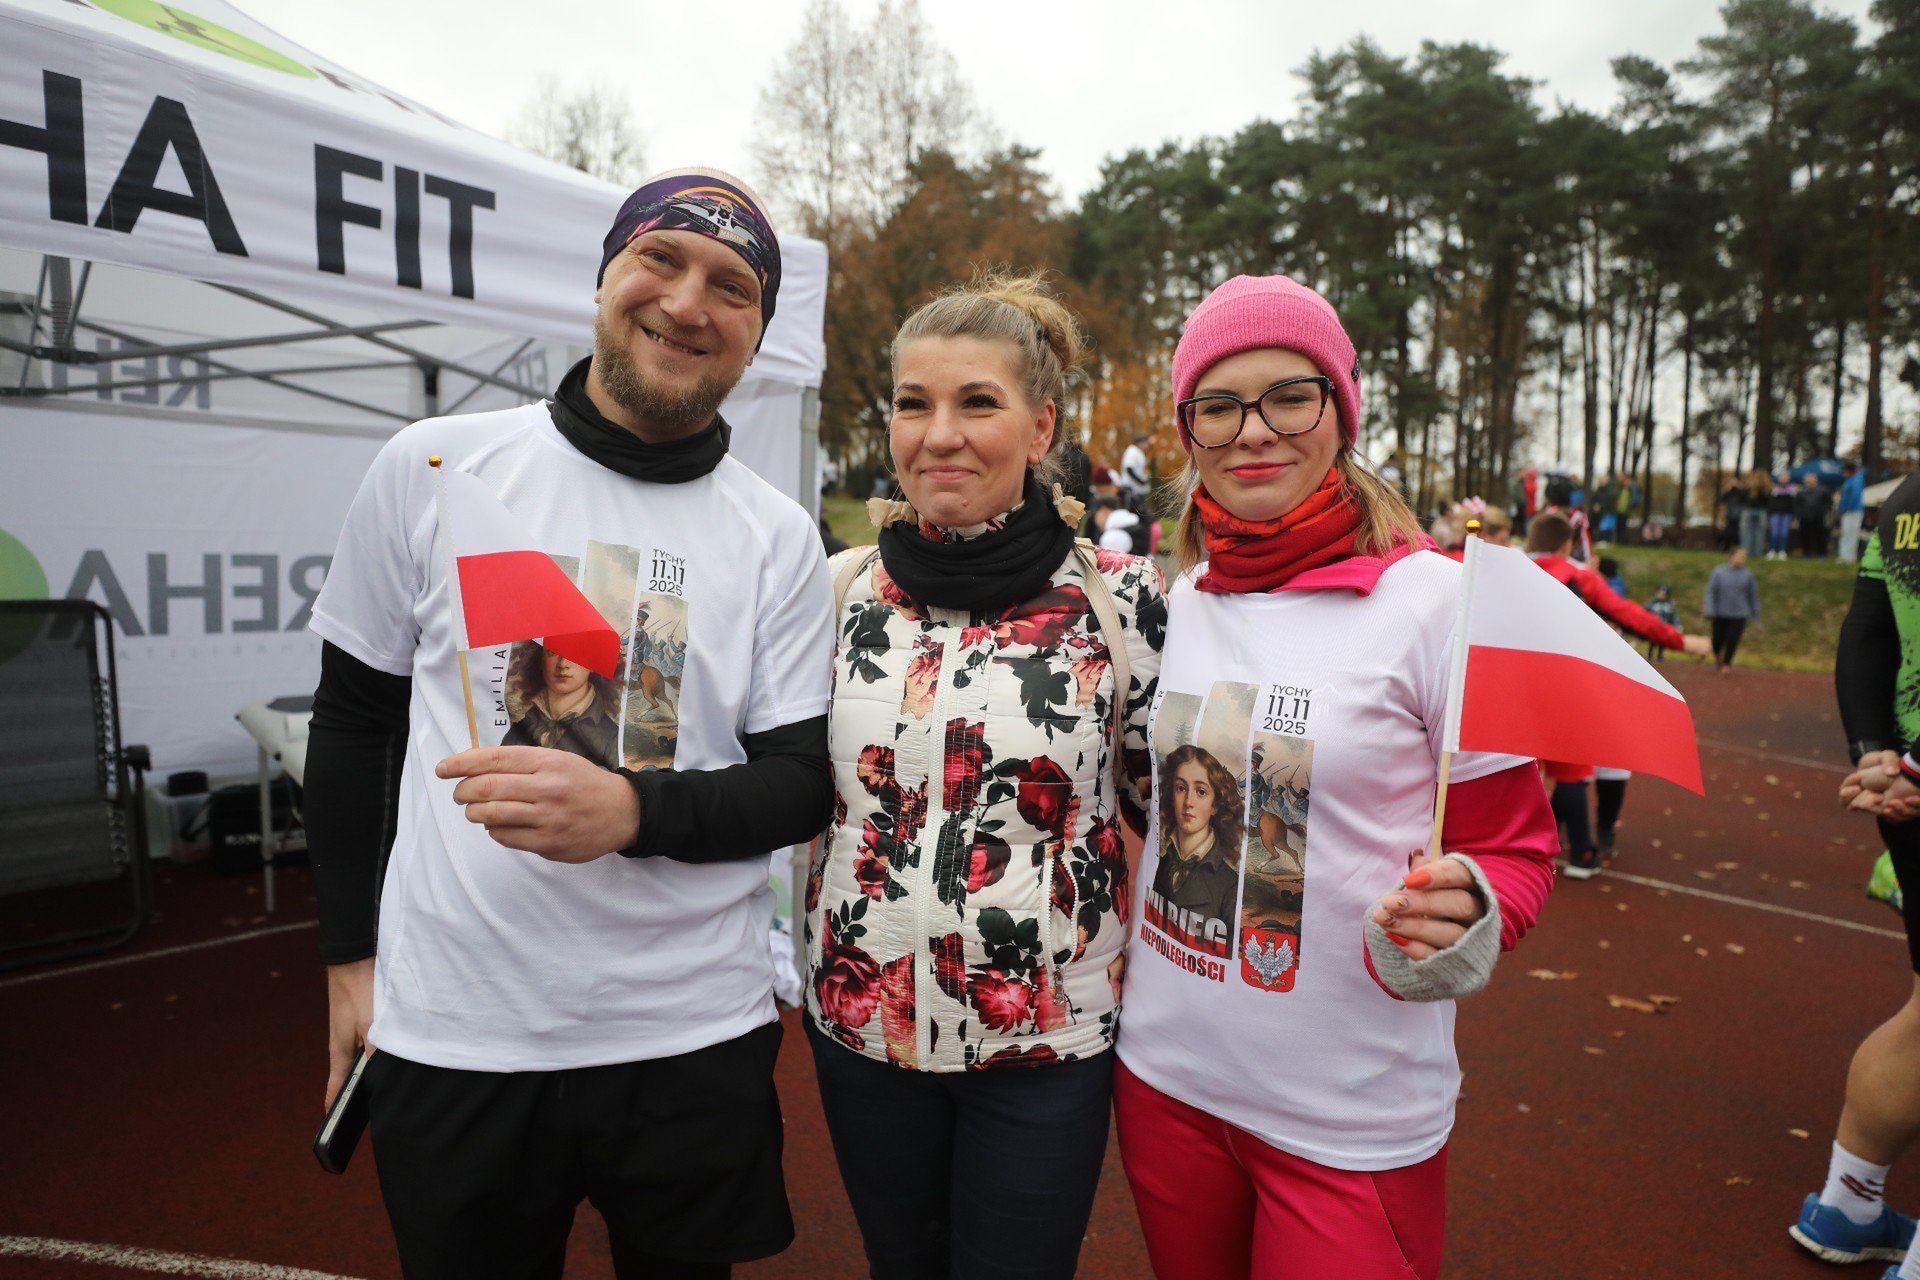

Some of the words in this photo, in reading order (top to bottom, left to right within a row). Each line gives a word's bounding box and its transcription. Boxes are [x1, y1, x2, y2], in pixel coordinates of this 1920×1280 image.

[314, 143, 496, 300] FIT
[653, 549, 686, 566] TYCHY
[652, 559, 685, 585] 11.11
[649, 579, 683, 596] 2025
[491, 649, 507, 726] EMILIA
[1272, 684, 1312, 698] TYCHY
[1268, 694, 1310, 721] 11.11
[1263, 716, 1306, 735] 2025
[1166, 899, 1229, 960] BIEG
[1140, 922, 1226, 983] NIEPODLEGŁOŚCI
